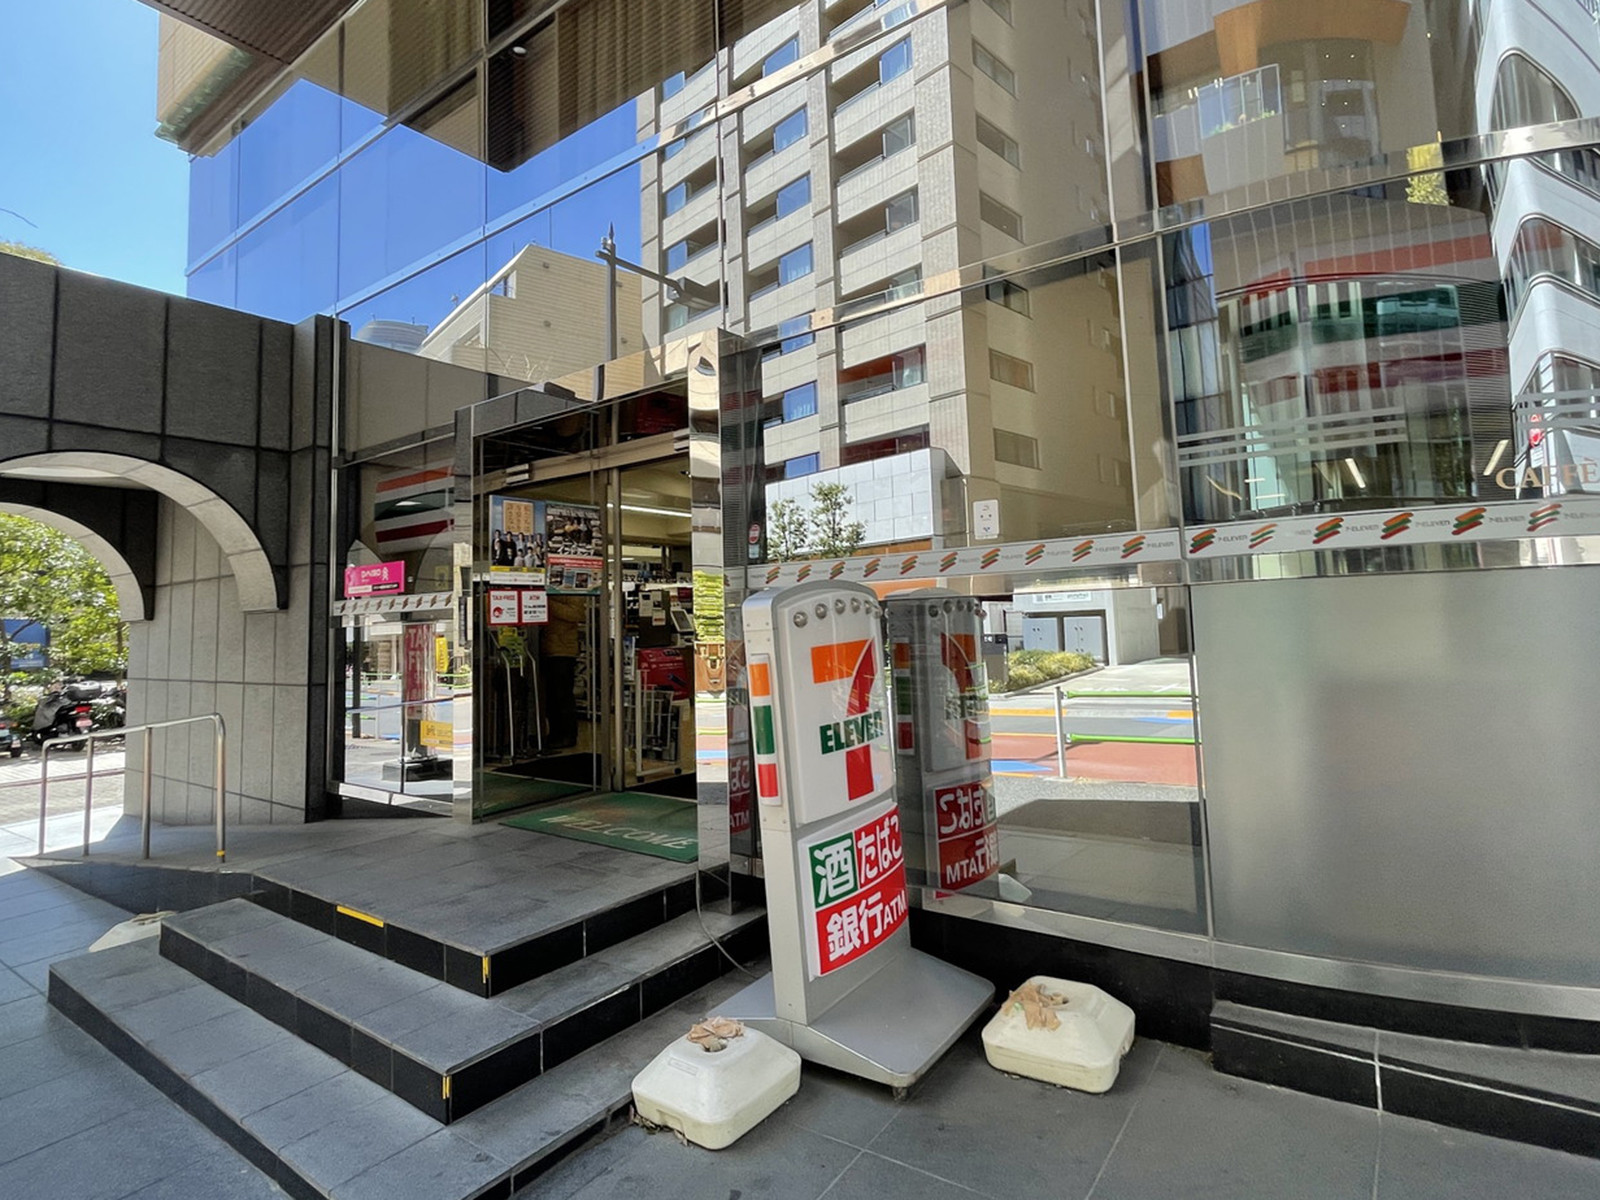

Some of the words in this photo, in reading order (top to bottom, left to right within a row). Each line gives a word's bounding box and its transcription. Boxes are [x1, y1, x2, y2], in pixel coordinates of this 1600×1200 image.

[539, 814, 698, 850] WELCOME
[857, 814, 903, 885] たばこ
[813, 837, 855, 904] 酒
